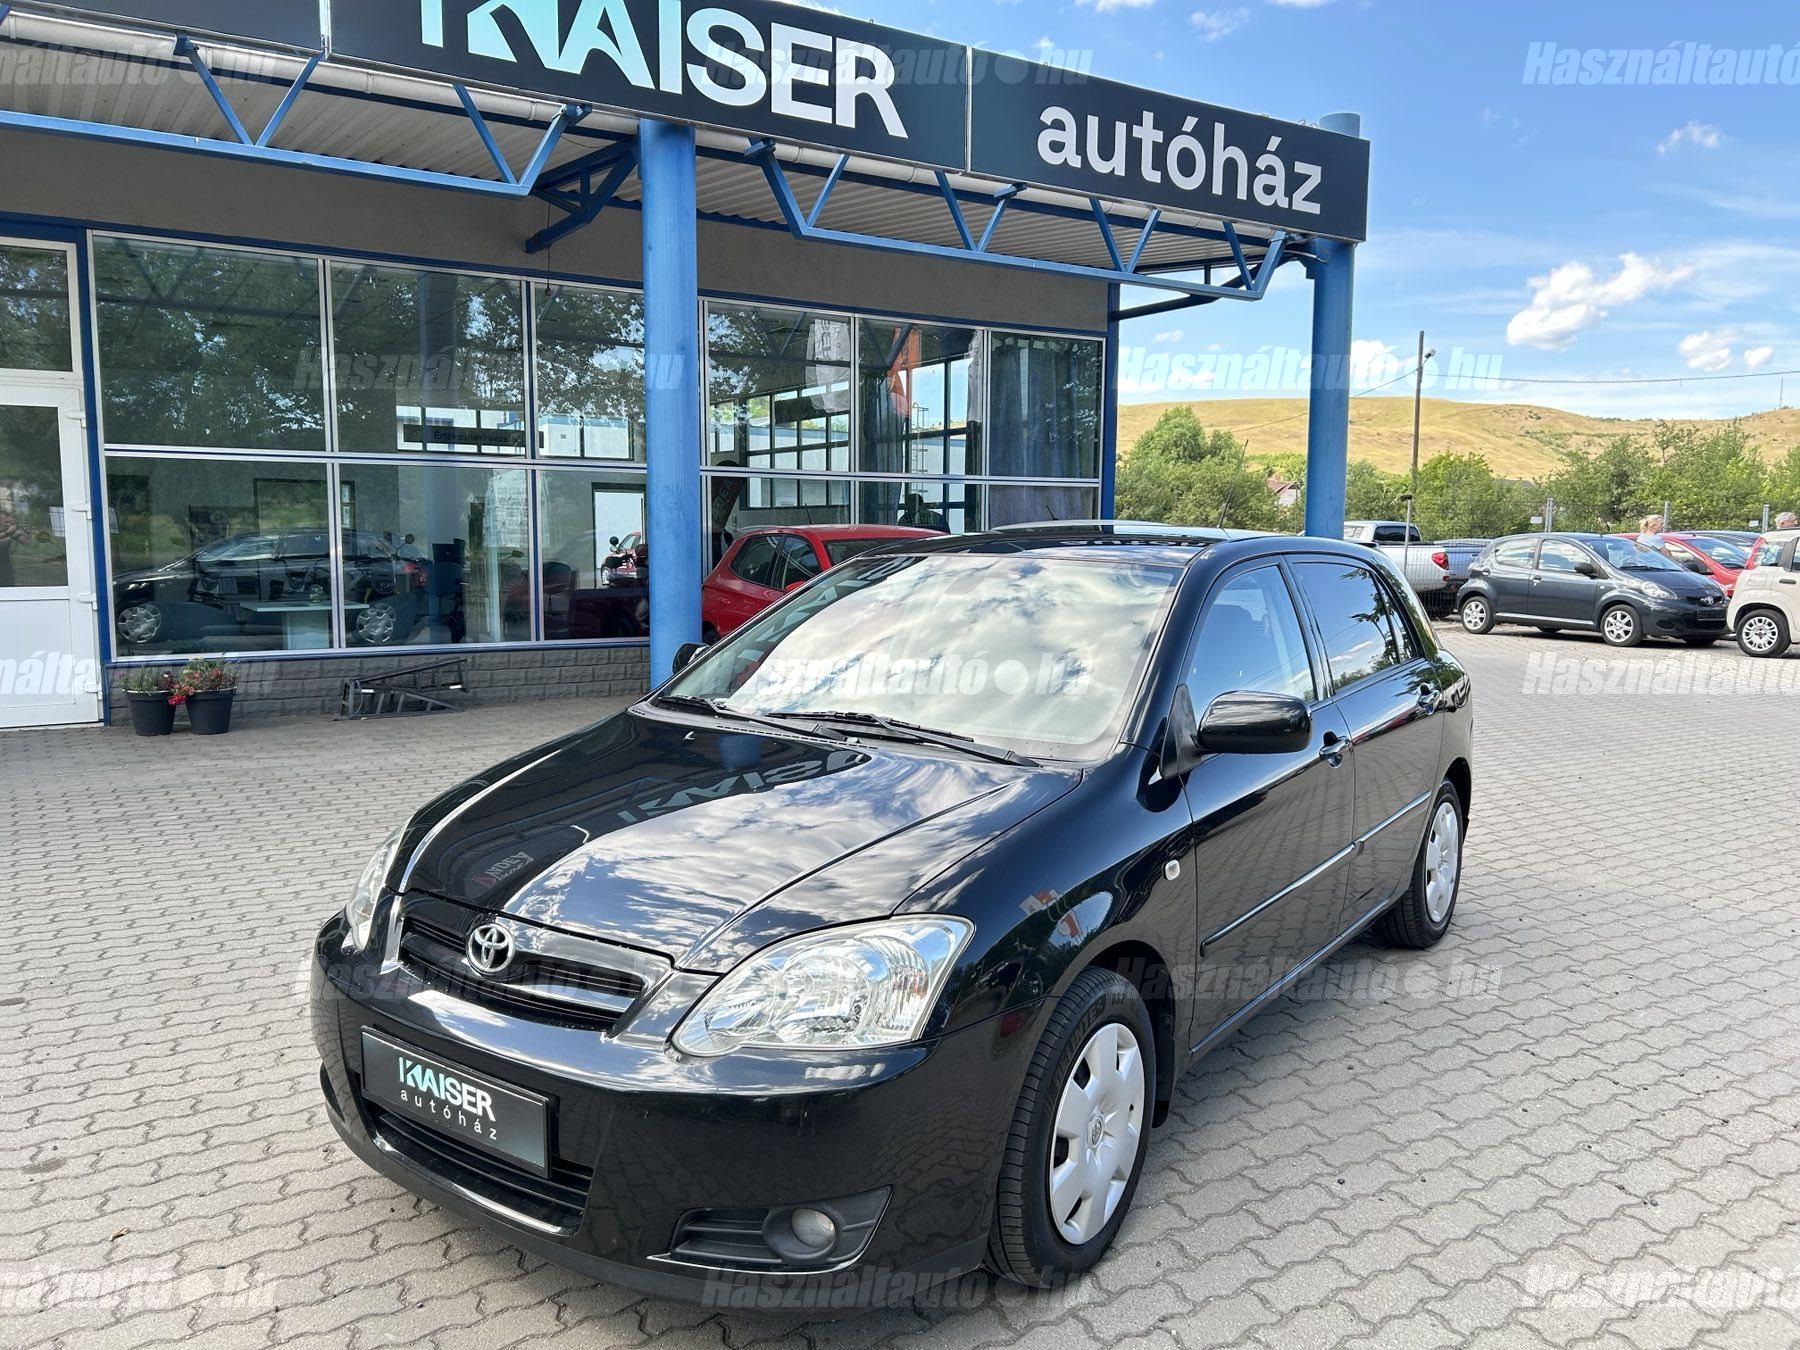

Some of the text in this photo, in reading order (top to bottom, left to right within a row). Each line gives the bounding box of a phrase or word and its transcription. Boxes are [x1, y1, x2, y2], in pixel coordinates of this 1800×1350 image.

[1037, 106, 1322, 215] autóház
[399, 1056, 496, 1122] KAISER
[400, 1089, 497, 1140] autóház
